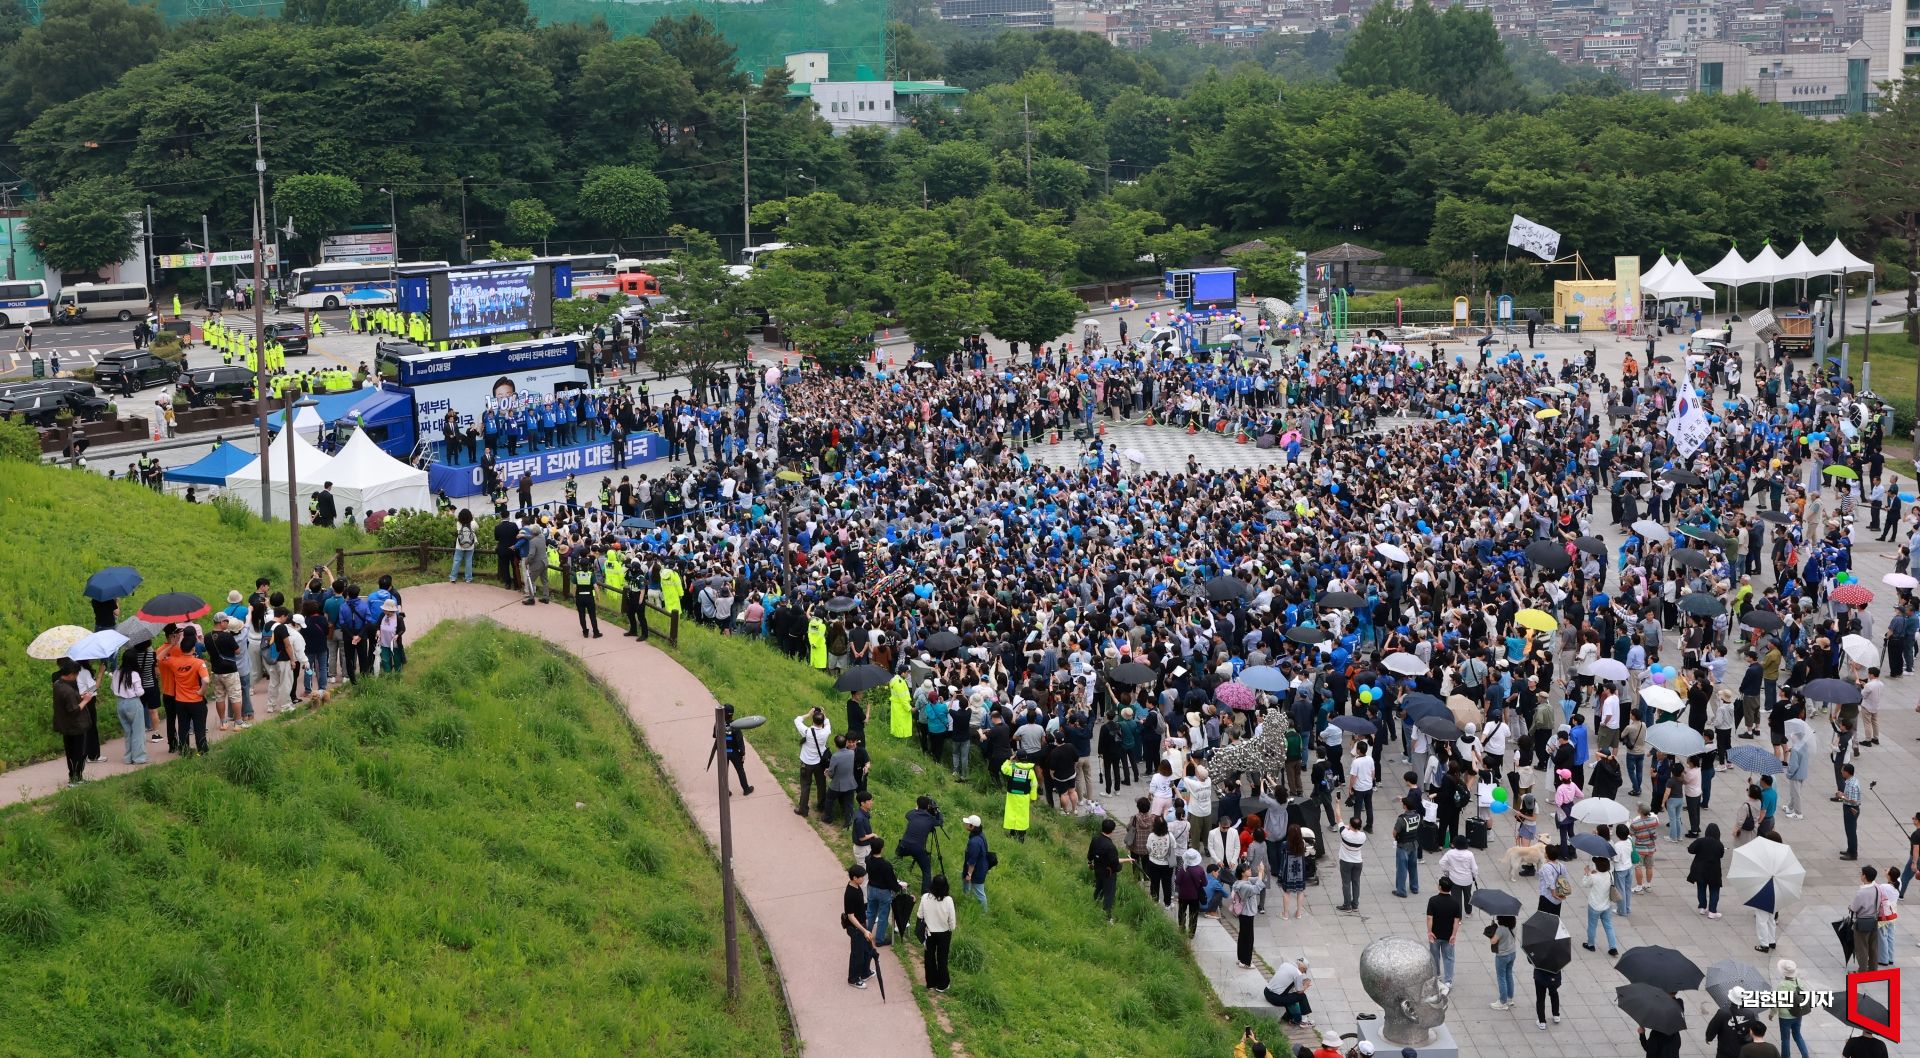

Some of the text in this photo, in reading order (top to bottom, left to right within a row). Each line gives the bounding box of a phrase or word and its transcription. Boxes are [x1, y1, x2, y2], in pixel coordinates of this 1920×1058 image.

[562, 276, 567, 287] 1
[415, 286, 421, 298] 1
[508, 346, 568, 363] 이제부터 진짜 대한민국
[408, 363, 414, 376] 1
[427, 362, 451, 374] 이재명
[547, 449, 581, 474] 진짜
